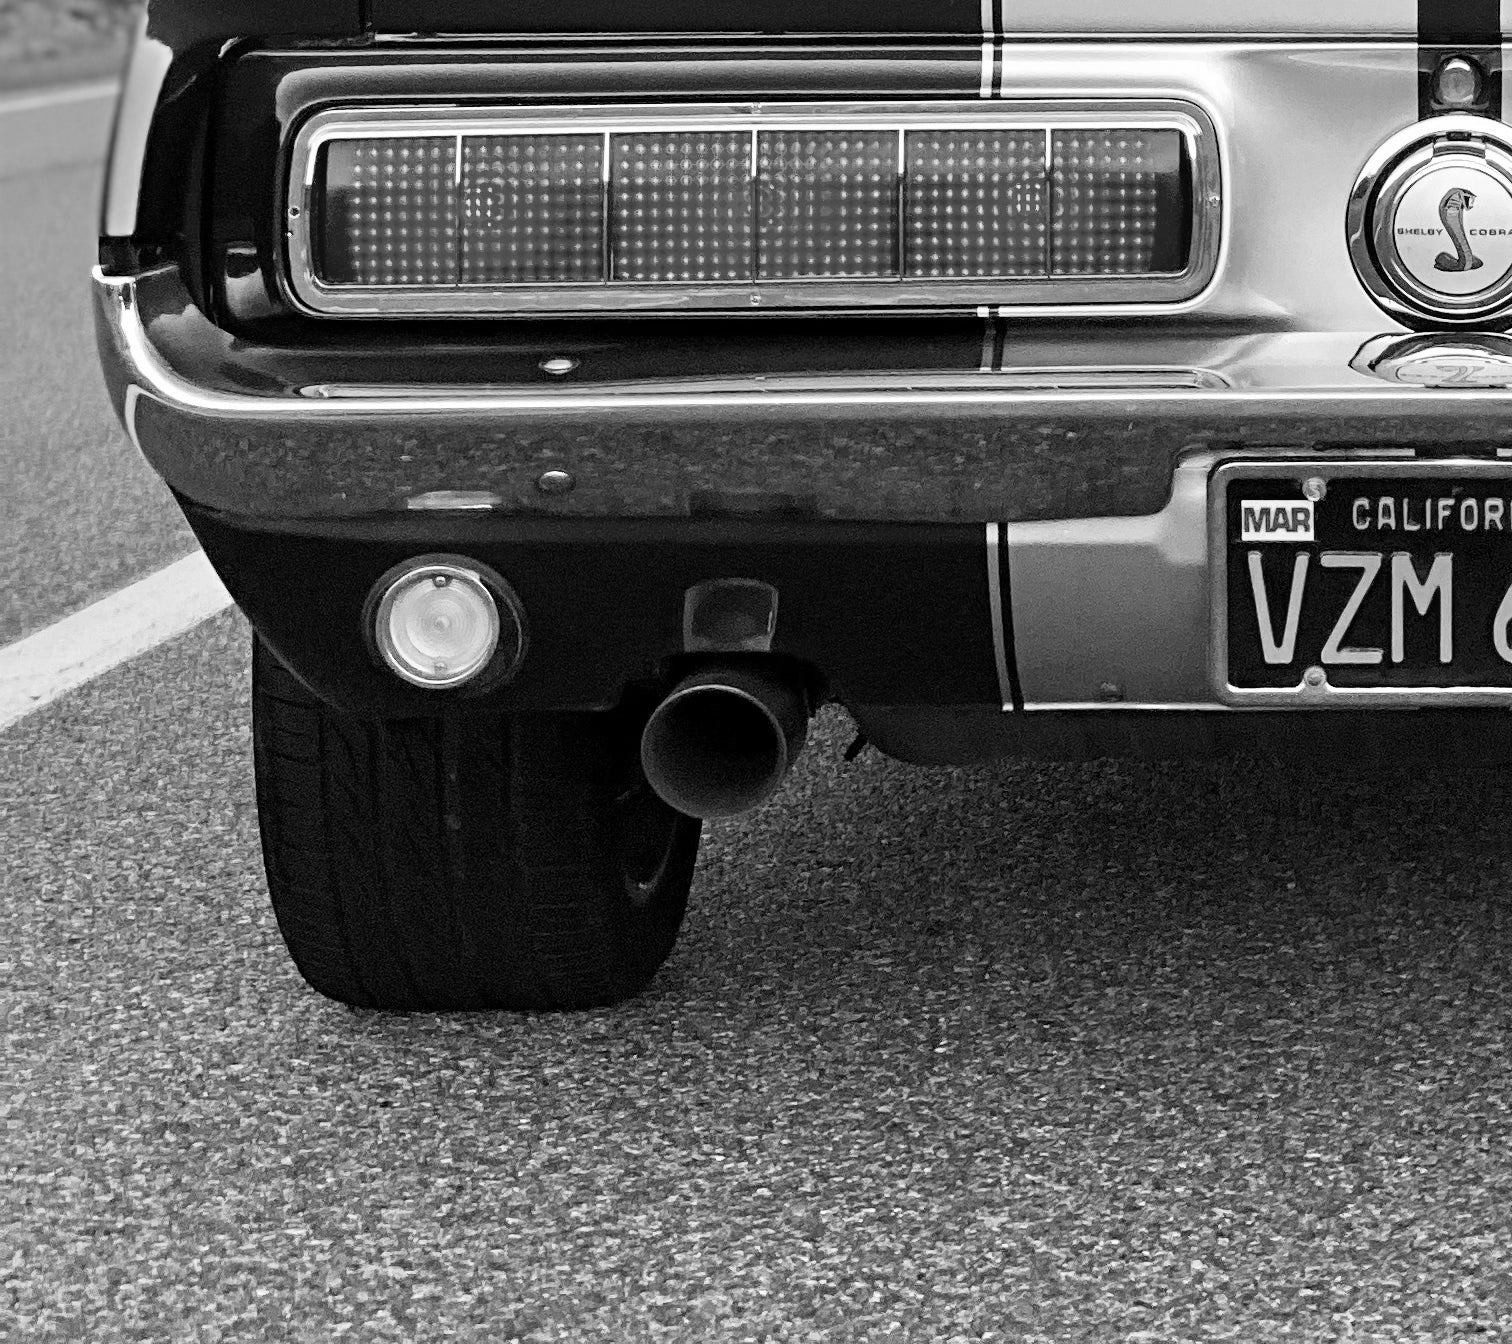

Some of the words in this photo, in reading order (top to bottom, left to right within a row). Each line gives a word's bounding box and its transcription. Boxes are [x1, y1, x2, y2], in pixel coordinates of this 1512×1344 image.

[1397, 227, 1443, 236] SHELBY
[1243, 506, 1312, 534] MAR
[1247, 550, 1454, 665] VZM
